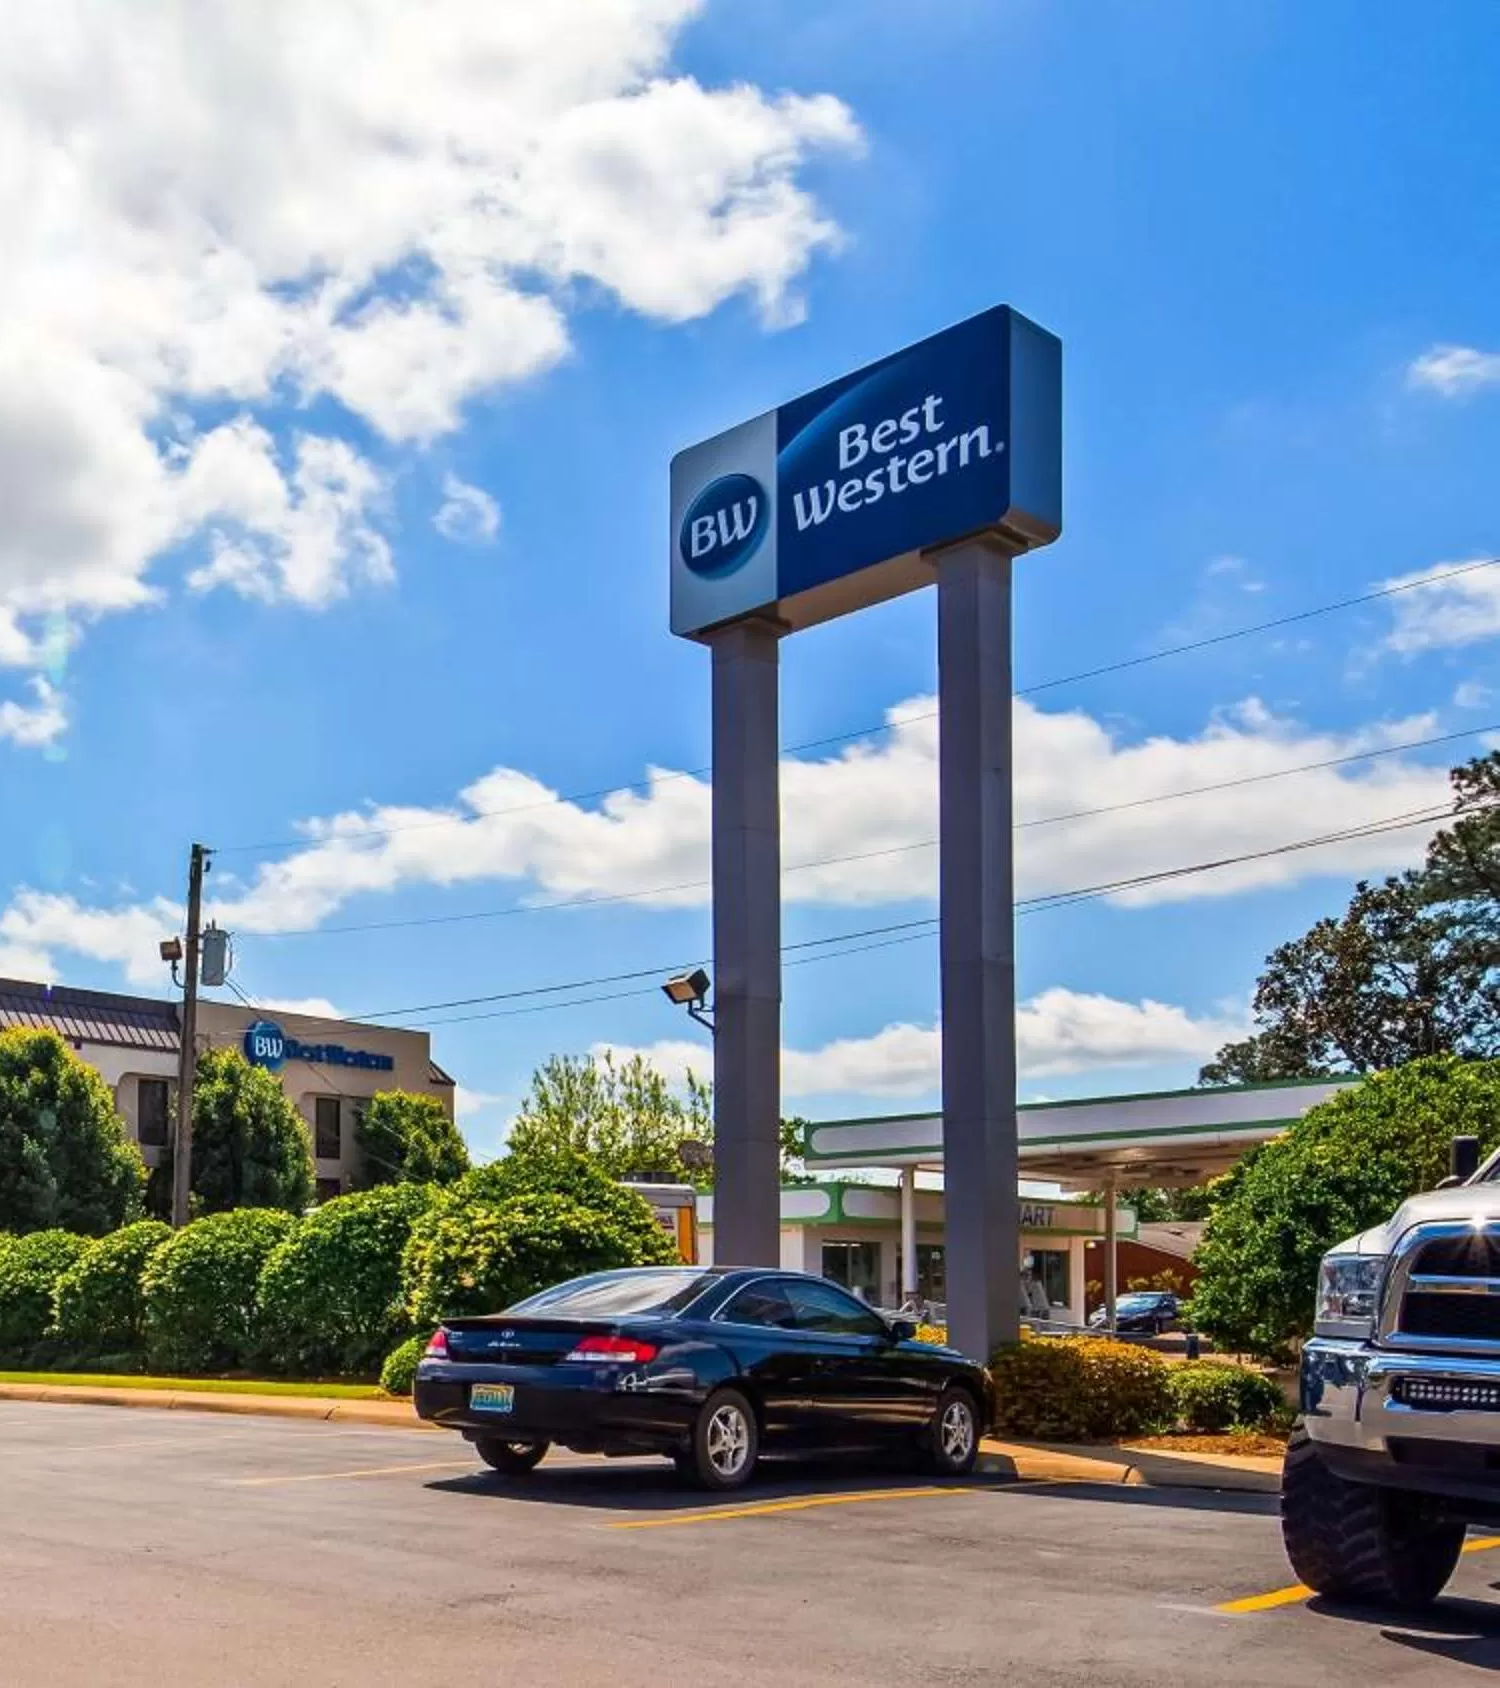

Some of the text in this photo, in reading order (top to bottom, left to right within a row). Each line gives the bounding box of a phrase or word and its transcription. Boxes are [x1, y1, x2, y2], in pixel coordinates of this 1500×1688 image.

[838, 394, 944, 471] Best
[690, 495, 758, 559] BW
[254, 1036, 283, 1059] BW
